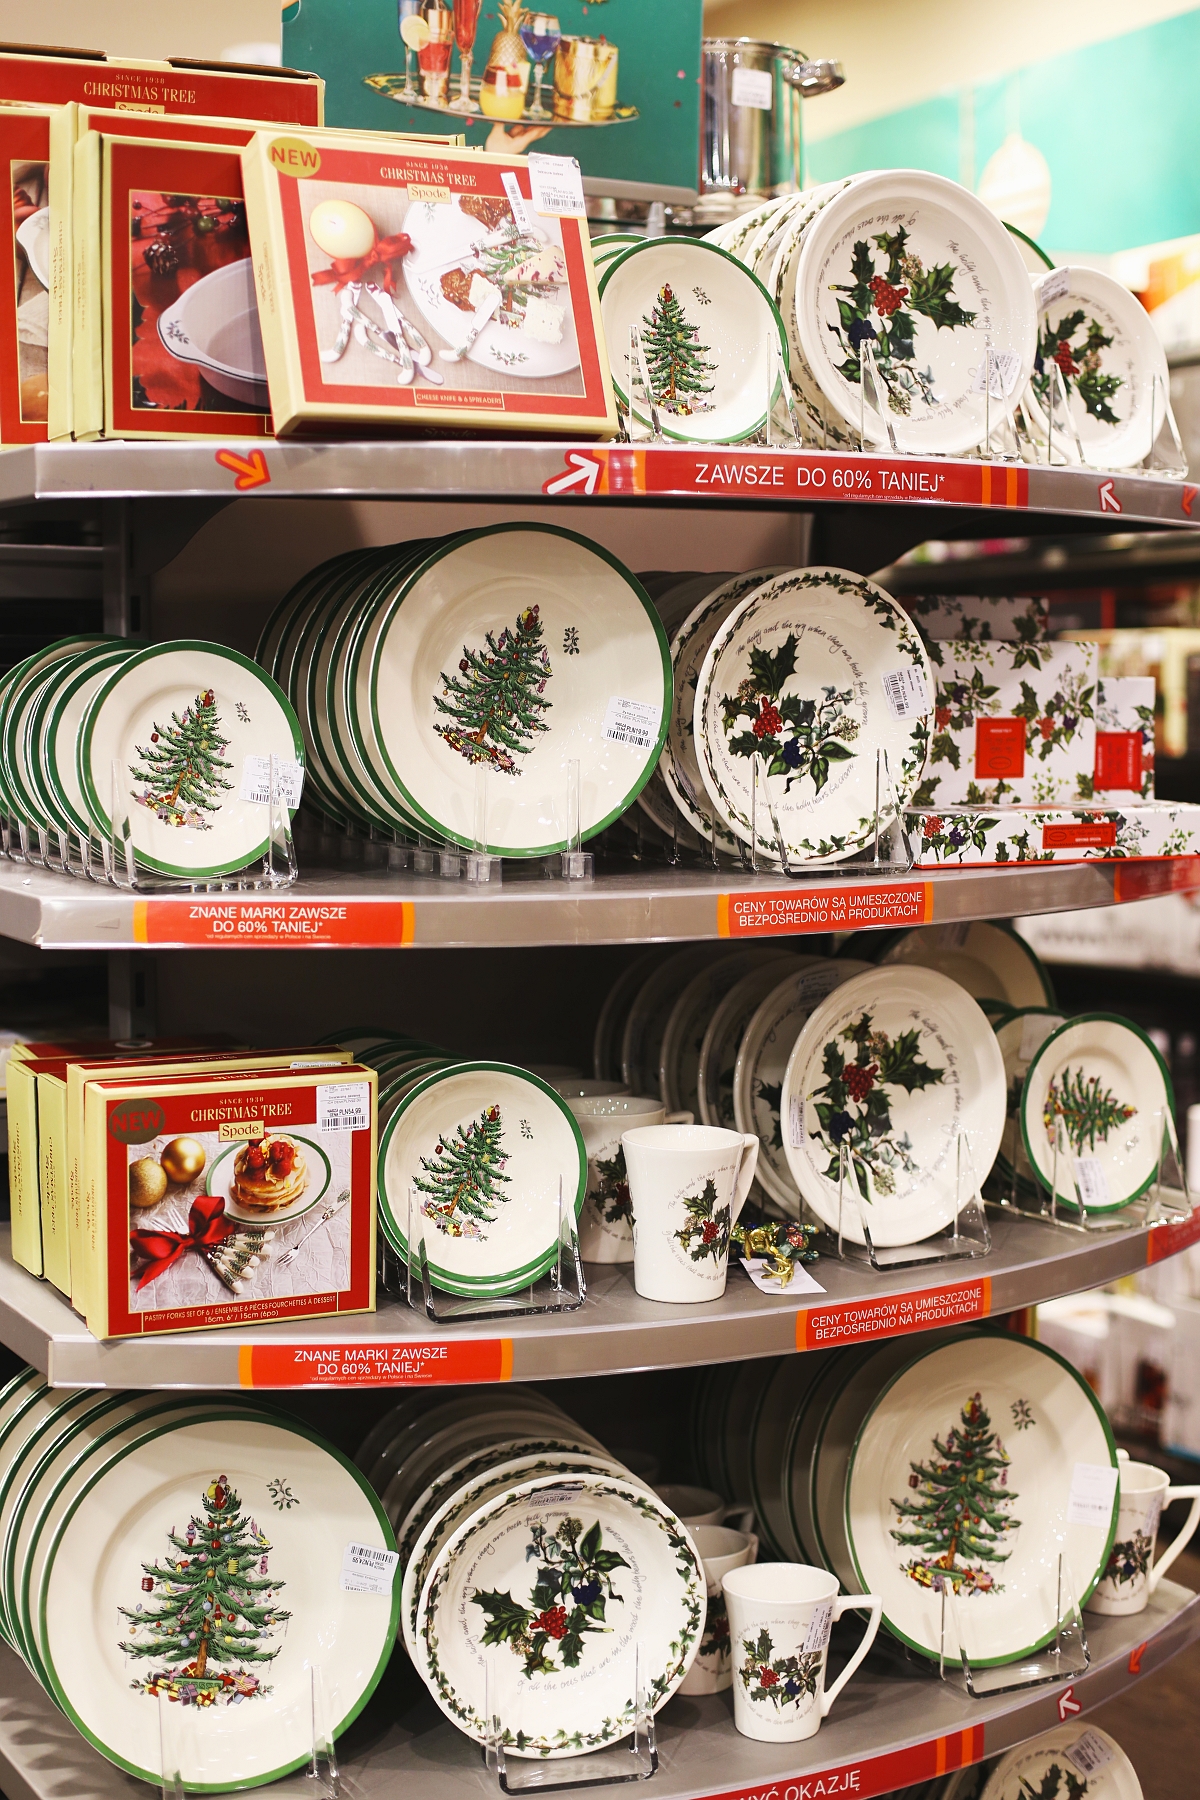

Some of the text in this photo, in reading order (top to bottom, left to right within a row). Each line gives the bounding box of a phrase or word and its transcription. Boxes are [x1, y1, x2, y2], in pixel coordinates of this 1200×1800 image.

[116, 74, 141, 82] SINCE
[84, 82, 196, 103] CHRISTMAS TREE
[271, 146, 318, 168] NEW
[406, 161, 428, 170] SINCE
[380, 167, 476, 186] CHRISTMAS TREE
[695, 464, 784, 485] ZAWSZE
[797, 468, 826, 487] DO
[832, 469, 871, 489] 60%
[189, 907, 346, 919] ZNANE MARKI ZAWSZE
[734, 892, 922, 914] CENY TOWARÓW SĄ UMIESZCZONE
[739, 905, 917, 926] BEZPOŚREDNIO NA PRODUKTACH
[213, 922, 234, 932] DO
[238, 922, 267, 933] 60%
[111, 1110, 164, 1133] NEW
[190, 1103, 292, 1123] CHRISTMAS TREE
[215, 1304, 243, 1314] ENSEMBLE
[249, 1302, 268, 1310] PIÈCES
[269, 1298, 306, 1308] FOURCHETTES
[260, 1310, 279, 1319] (6po)
[812, 1287, 981, 1328] CENY TOWARÓW SĄ UMIESZCZONE
[816, 1301, 977, 1340] BEZPOŚREDNIO NA PRODUKTACH
[294, 1348, 447, 1362] ZNANE MARKI ZAWSZE
[318, 1364, 338, 1374] DO
[342, 1363, 370, 1374] 60%
[785, 1770, 860, 1800] OKAZJĘ
